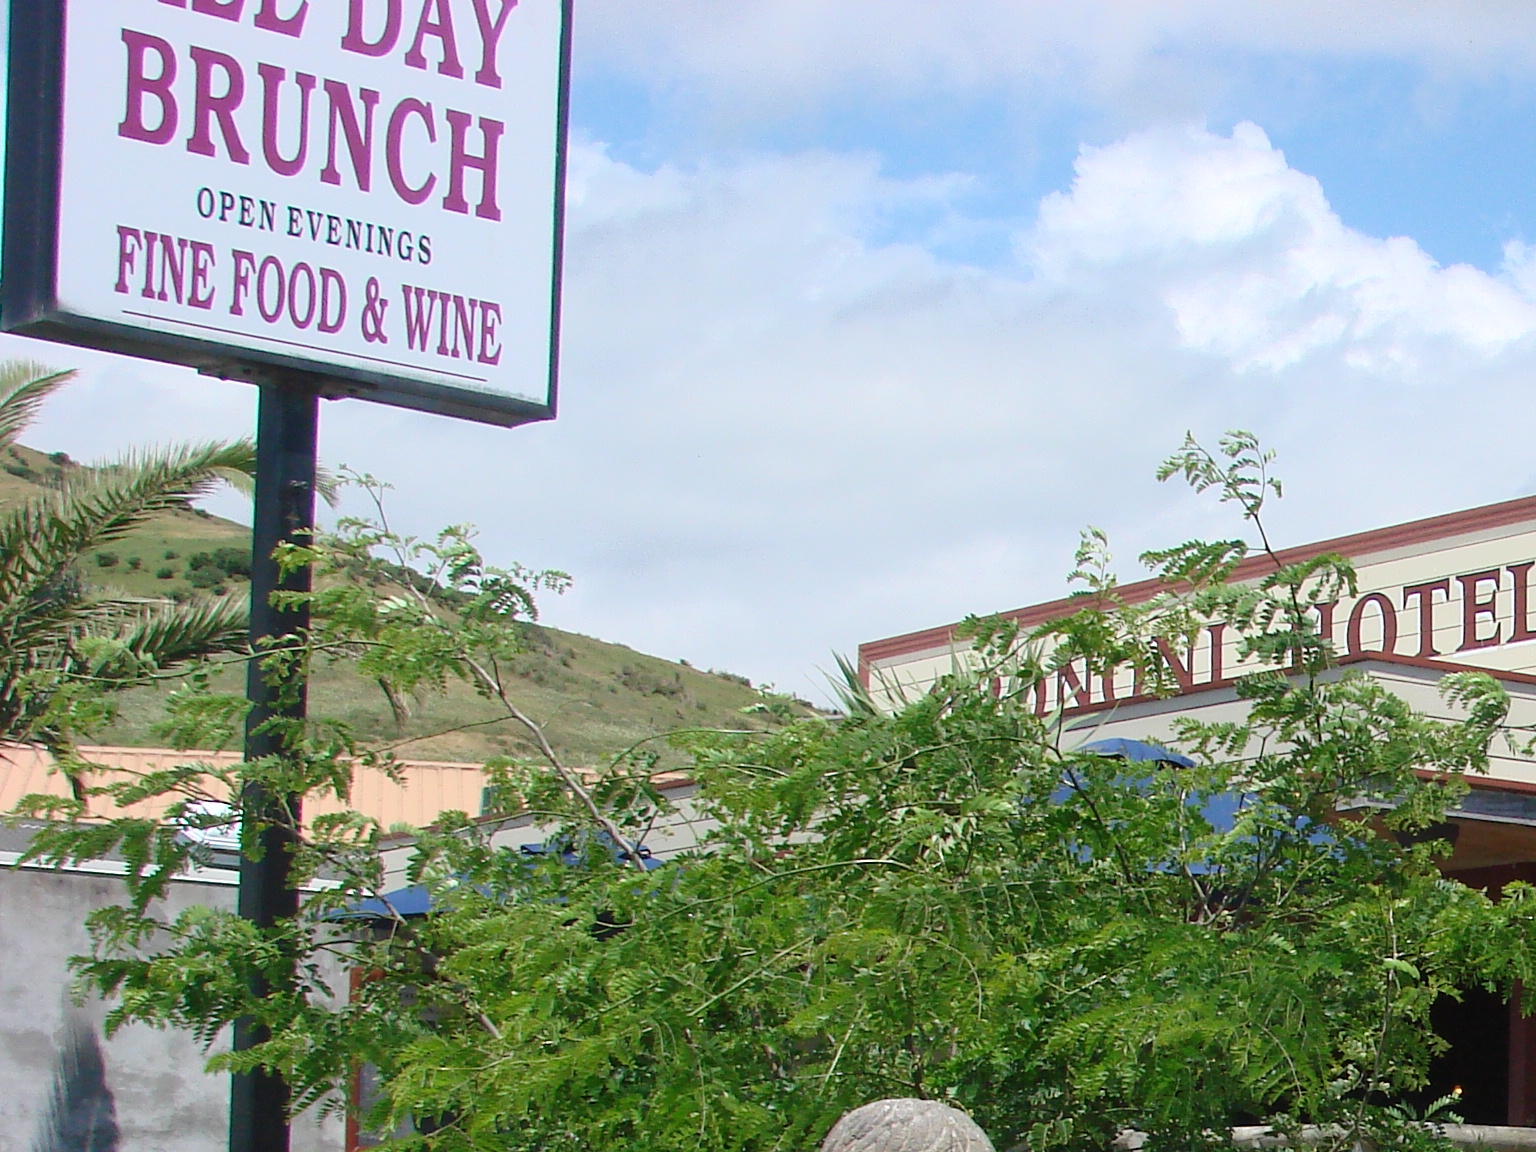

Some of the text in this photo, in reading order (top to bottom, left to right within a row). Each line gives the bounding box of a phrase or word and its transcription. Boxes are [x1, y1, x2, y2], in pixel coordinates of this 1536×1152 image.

[340, 0, 519, 89] DAY
[118, 28, 505, 222] BRUNCH
[197, 187, 433, 265] OPEN EVENINGS
[115, 225, 503, 366] FINE FOOD & WINE
